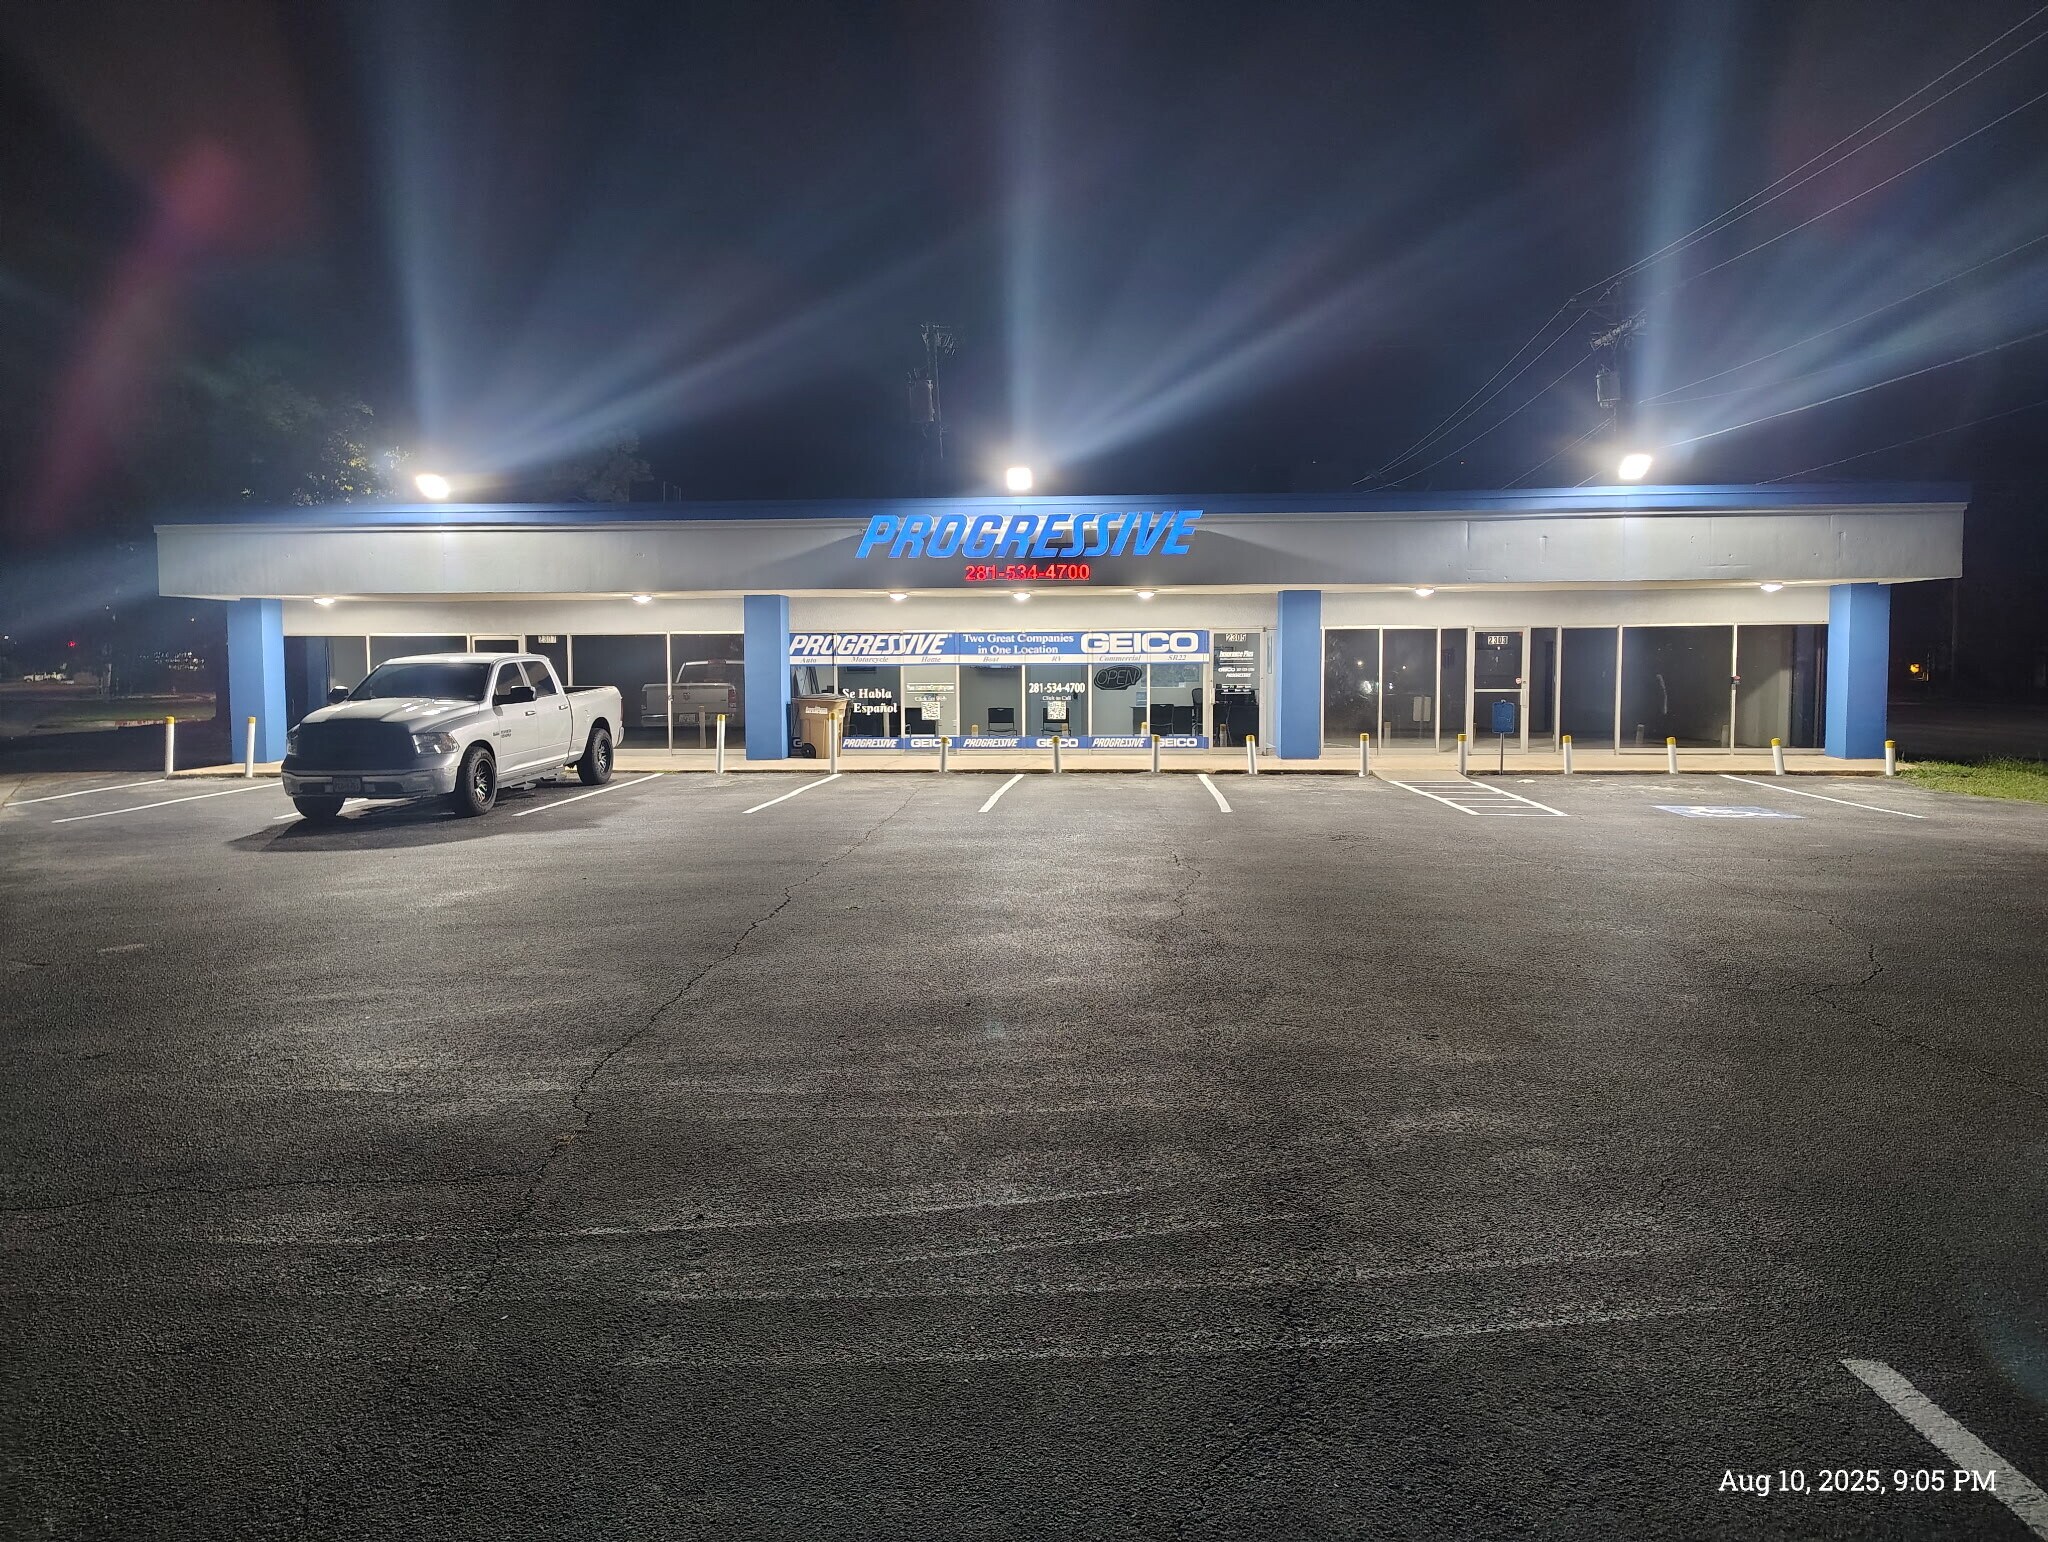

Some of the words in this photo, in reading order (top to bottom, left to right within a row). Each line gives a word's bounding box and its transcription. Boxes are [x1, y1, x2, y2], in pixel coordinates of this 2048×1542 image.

[855, 510, 1204, 558] PROGRESSIVE
[965, 565, 1089, 580] 281-534-4700
[789, 634, 946, 655] PROGRESSIVE
[963, 634, 984, 642] Two
[987, 634, 1015, 643] Great
[1017, 634, 1074, 644] Companies
[1081, 632, 1199, 653] GEICO
[1488, 636, 1508, 644] 2303
[977, 645, 987, 654] in
[990, 645, 1011, 654] One
[1014, 645, 1058, 654] Location
[1098, 669, 1138, 685] OPEN
[842, 688, 855, 699] Se
[858, 688, 893, 699] Habla
[1028, 683, 1086, 694] 281-534-4700
[853, 702, 897, 715] Español
[843, 738, 898, 748] PROGRESSIVE
[963, 738, 1018, 748] PROGRESSIVE
[1036, 738, 1078, 748] GECO
[1092, 738, 1146, 748] PROGRESSIVE
